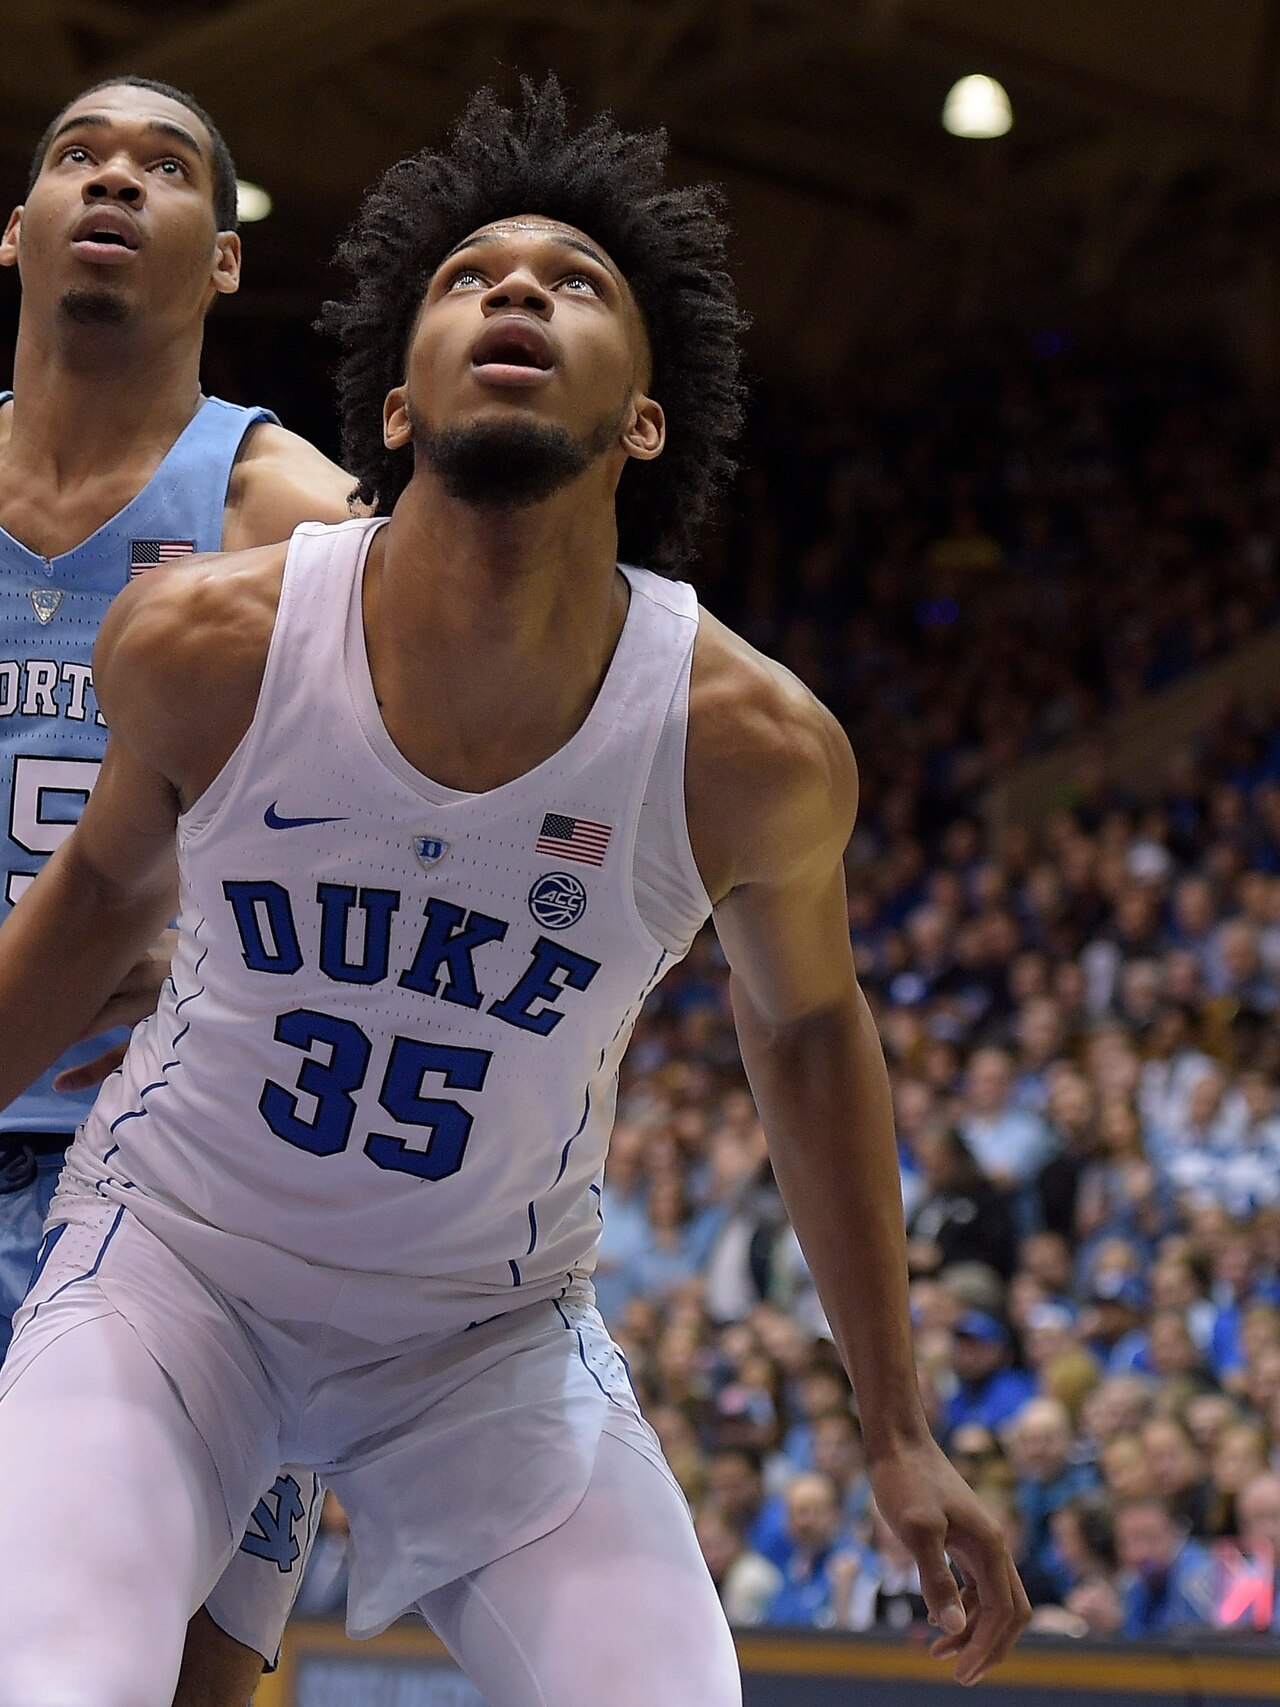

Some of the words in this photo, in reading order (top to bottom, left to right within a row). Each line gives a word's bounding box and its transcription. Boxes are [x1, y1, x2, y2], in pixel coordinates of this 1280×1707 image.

[222, 880, 603, 1037] DUKE
[540, 889, 585, 909] ACC
[258, 1008, 494, 1182] 35
